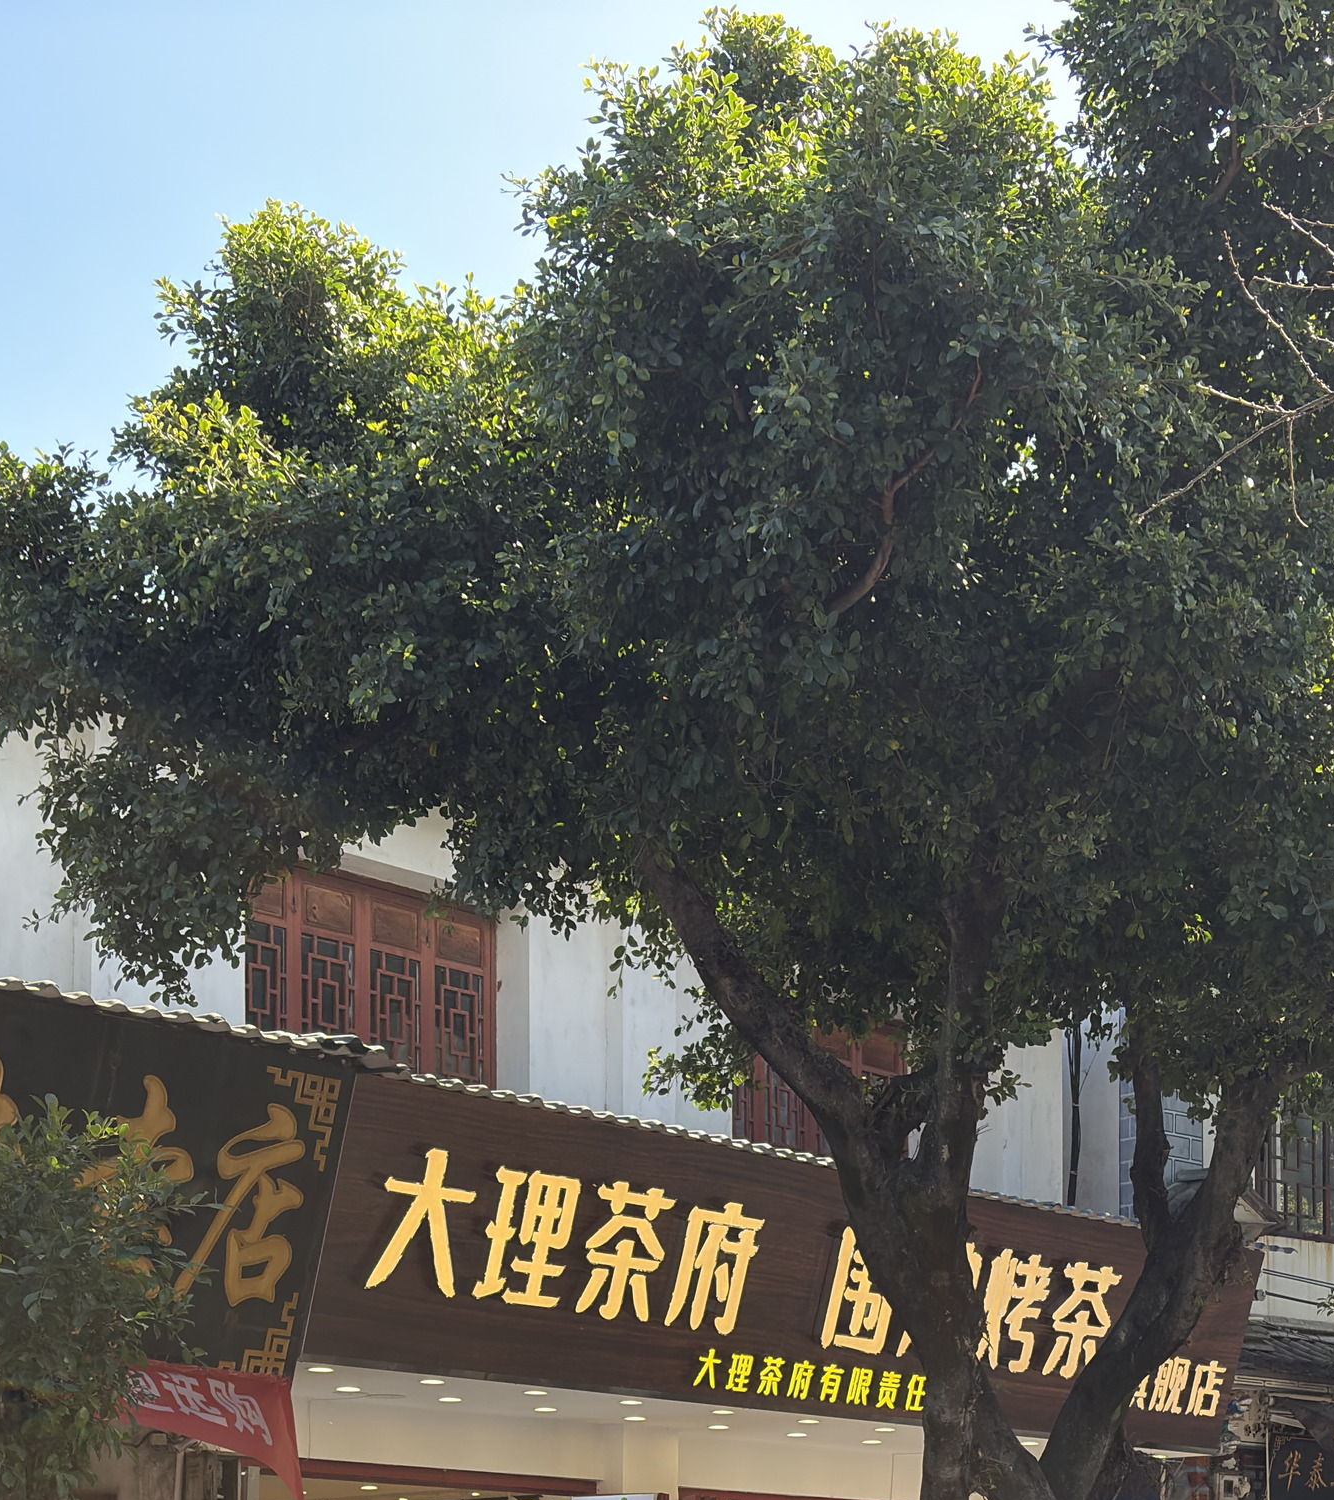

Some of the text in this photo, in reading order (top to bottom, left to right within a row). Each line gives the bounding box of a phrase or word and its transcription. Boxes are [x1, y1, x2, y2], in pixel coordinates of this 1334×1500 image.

[365, 1148, 765, 1335] 大理茶府
[820, 1226, 1121, 1380] 围烤茶
[693, 1348, 927, 1412] 大理茶府有限责任
